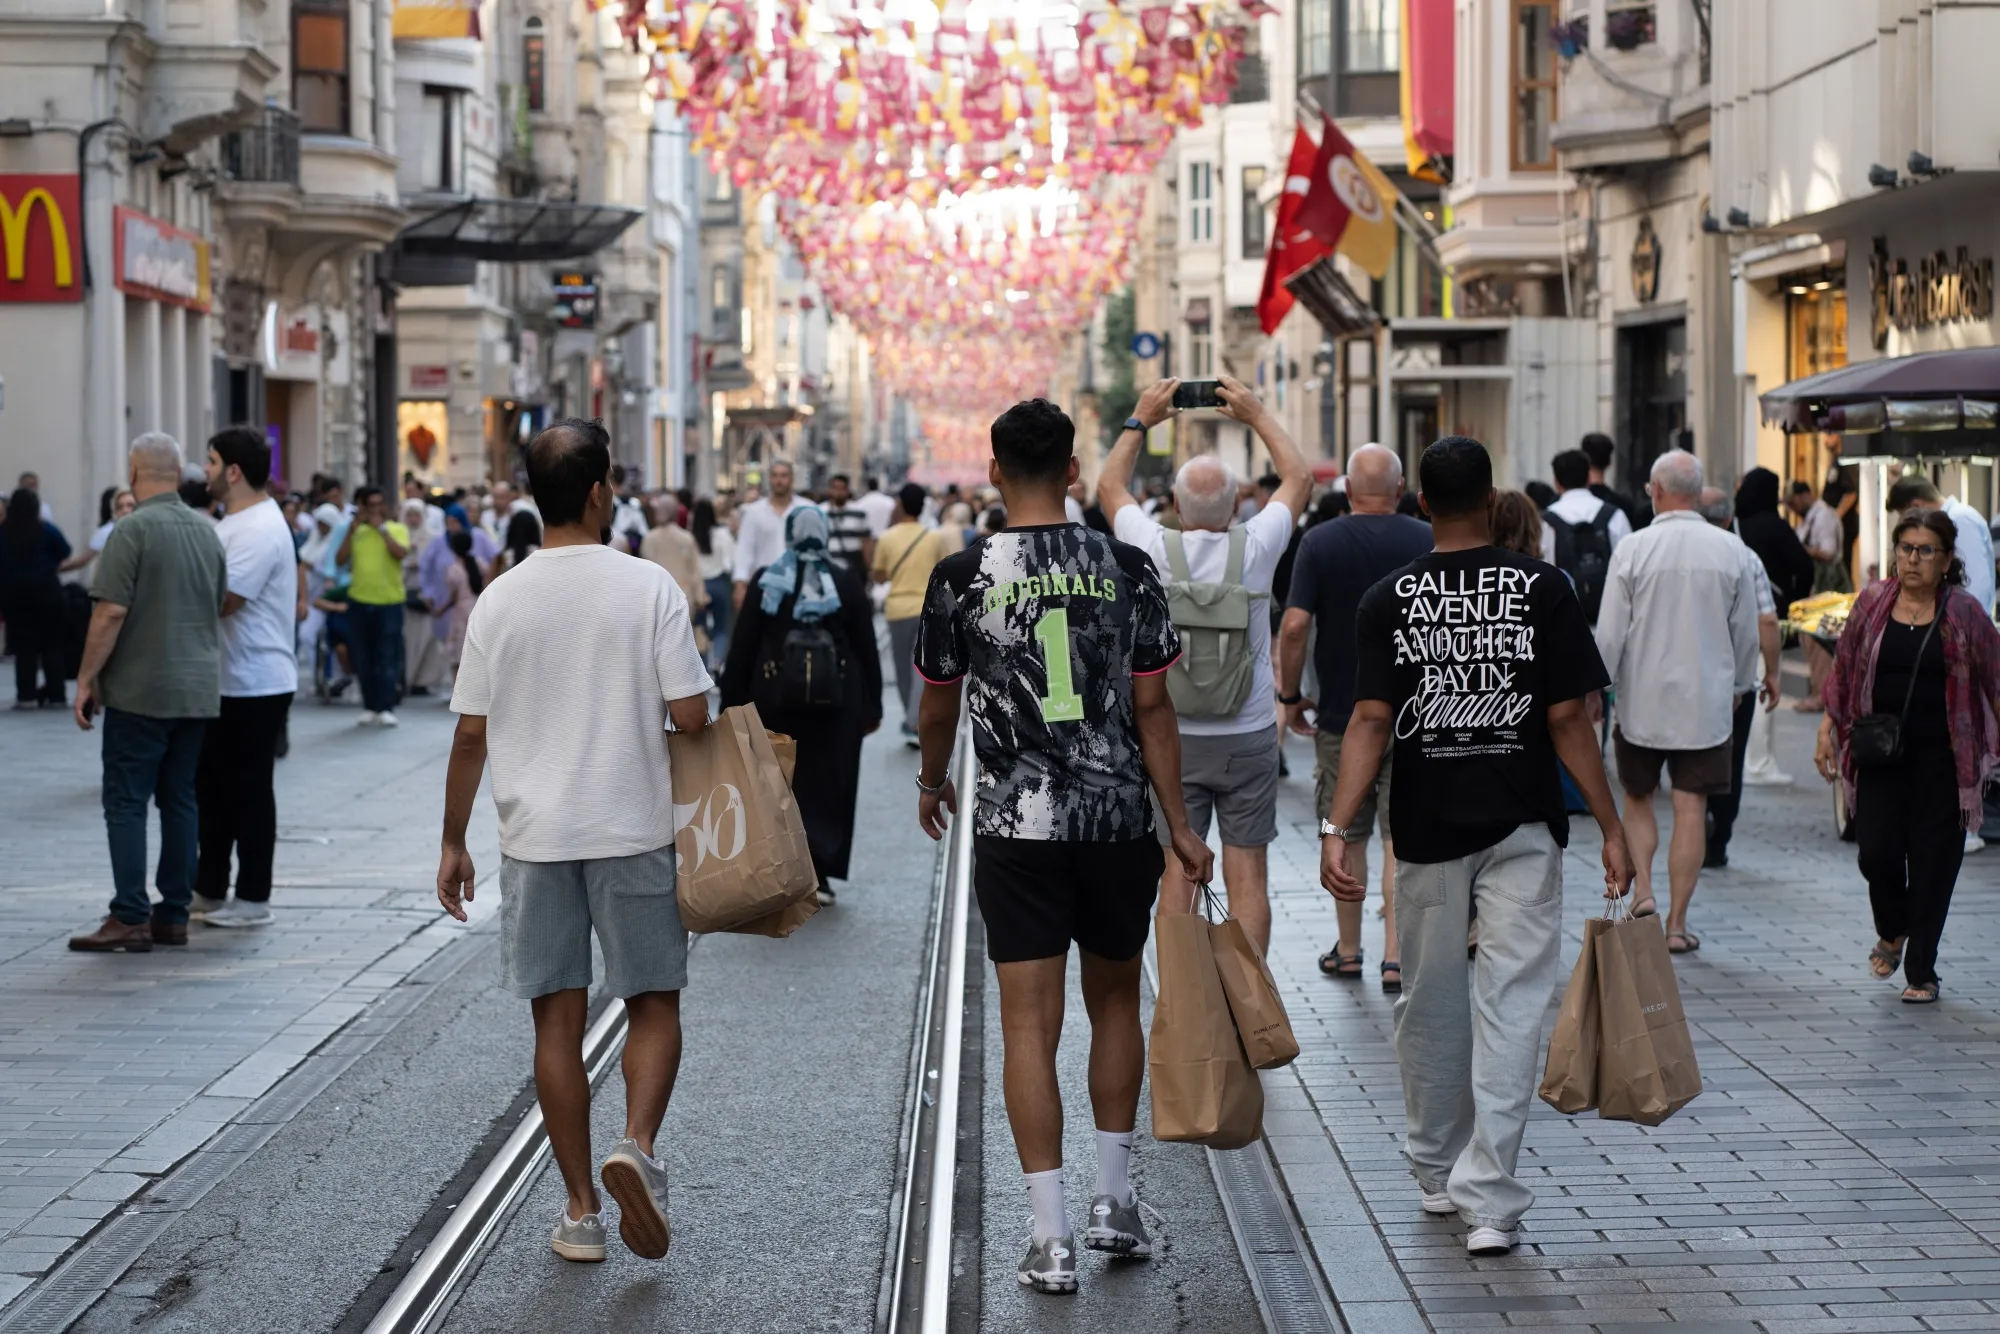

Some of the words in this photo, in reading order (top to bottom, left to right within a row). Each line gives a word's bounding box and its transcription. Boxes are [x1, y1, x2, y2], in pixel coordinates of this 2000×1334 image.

[985, 573, 1117, 613] ORIGINALS
[1395, 566, 1540, 598] GALLERY
[1033, 607, 1085, 723] 1
[1393, 622, 1536, 666] ANOTHER
[1422, 664, 1475, 693] DAY
[1478, 662, 1512, 691] IN
[1395, 672, 1533, 740] Paradise
